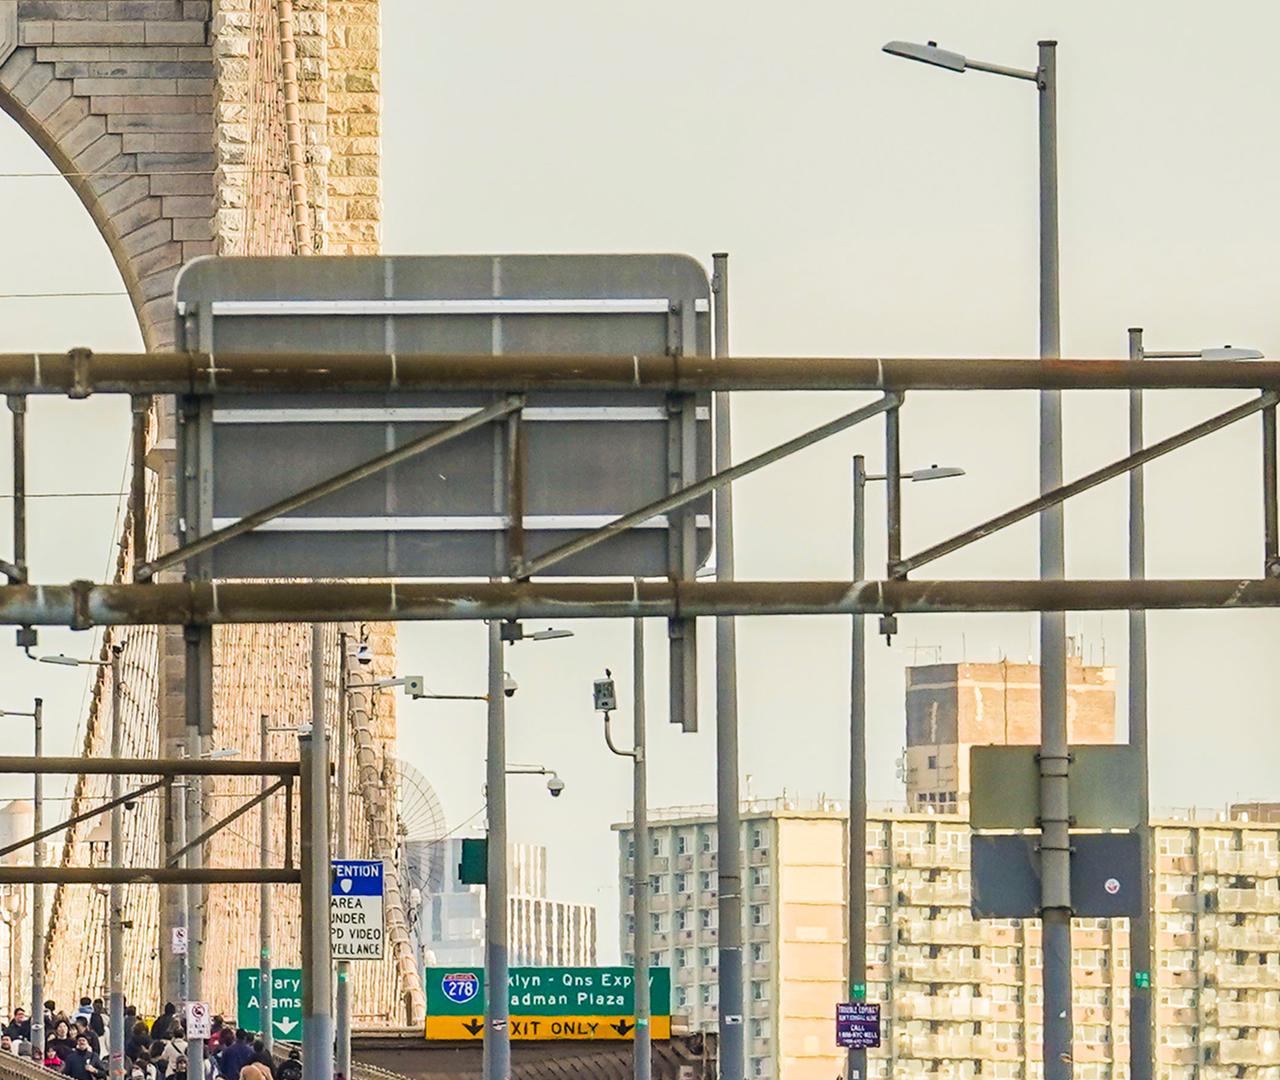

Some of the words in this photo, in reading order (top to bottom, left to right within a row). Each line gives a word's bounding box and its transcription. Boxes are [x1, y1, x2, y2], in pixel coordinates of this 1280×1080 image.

[331, 898, 363, 909] AREA
[331, 928, 344, 939] PD
[349, 929, 380, 940] VIDEO
[332, 944, 380, 955] VEILLANCE
[249, 976, 300, 993] Tary
[563, 974, 593, 987] Qns
[448, 981, 474, 997] 278
[247, 996, 302, 1009] Aams
[511, 993, 568, 1006] adman
[577, 992, 625, 1006] Plaza
[511, 1021, 541, 1035] XIT
[551, 1021, 600, 1035] ONLY
